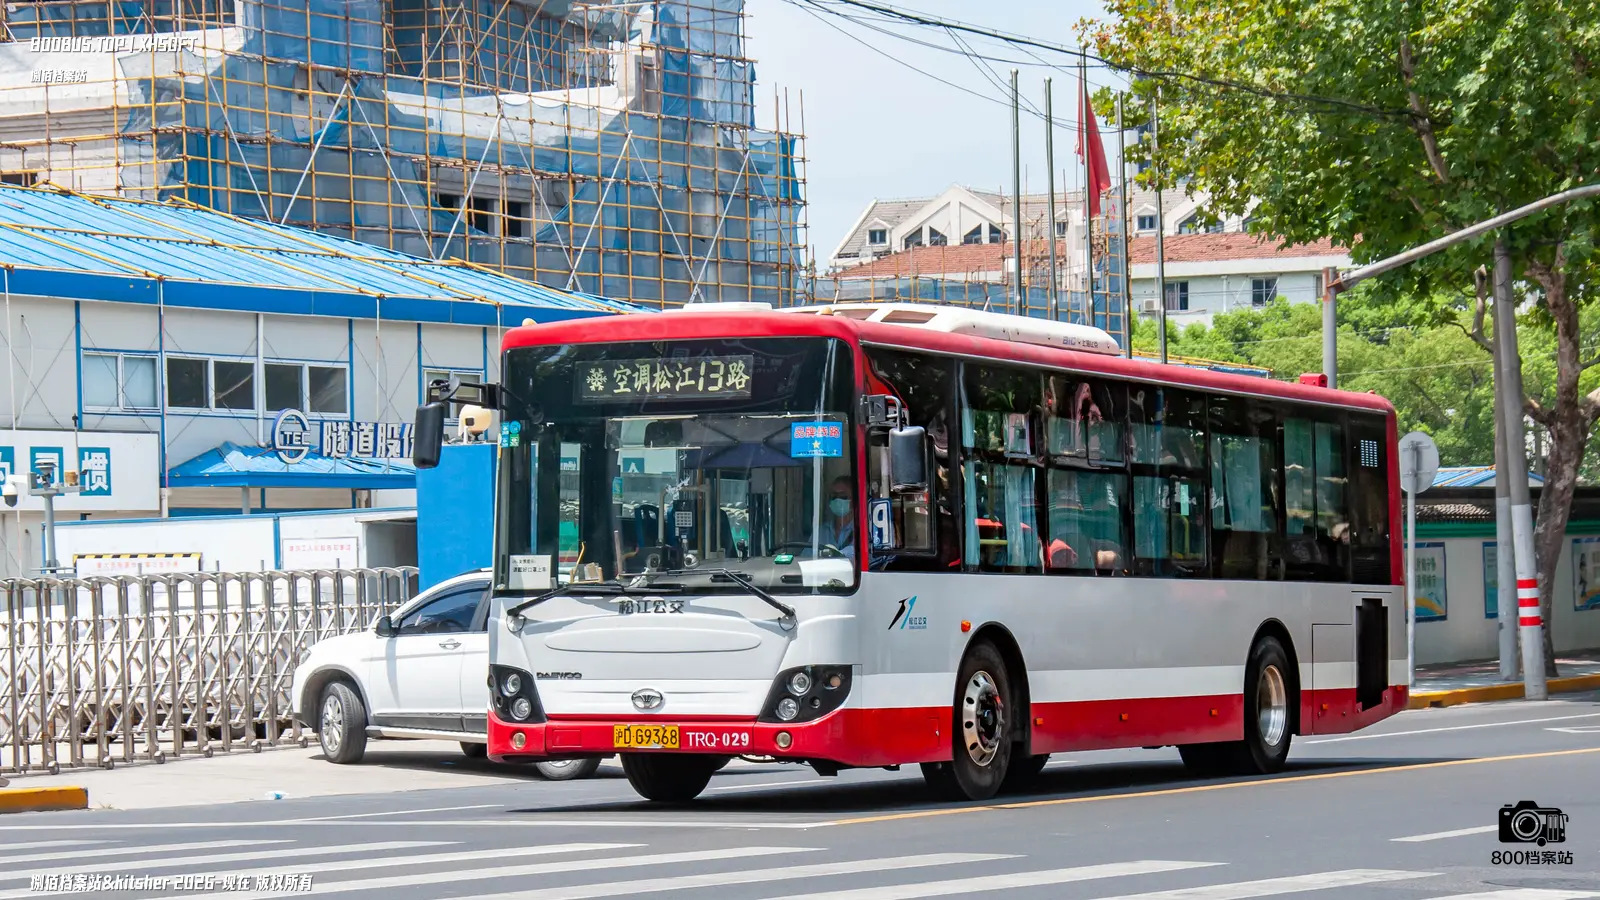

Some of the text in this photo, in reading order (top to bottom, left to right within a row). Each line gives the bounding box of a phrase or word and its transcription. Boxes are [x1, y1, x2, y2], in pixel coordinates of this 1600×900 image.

[613, 359, 750, 393] 空调松江13路
[619, 600, 684, 614] 松江公交
